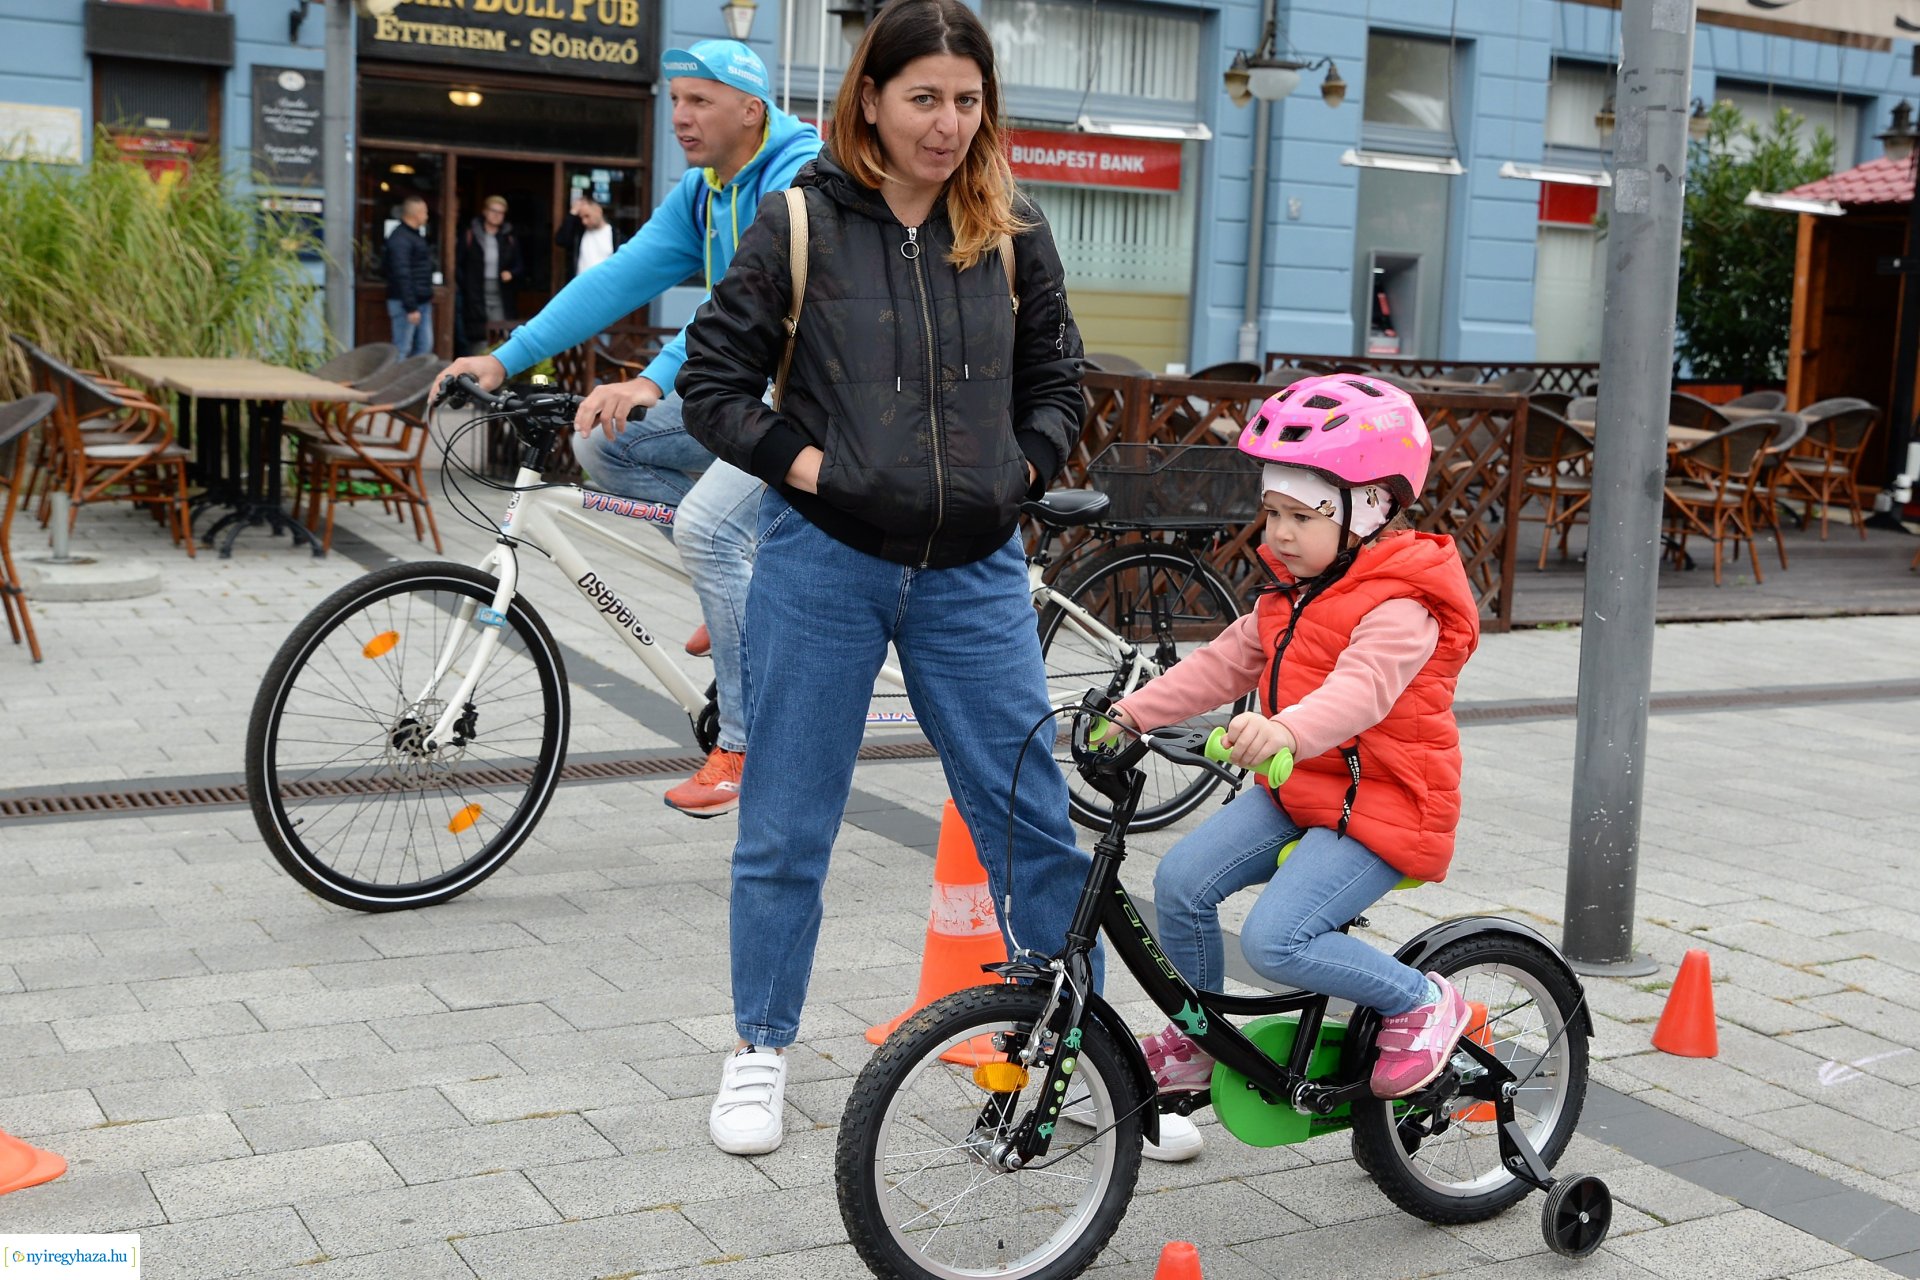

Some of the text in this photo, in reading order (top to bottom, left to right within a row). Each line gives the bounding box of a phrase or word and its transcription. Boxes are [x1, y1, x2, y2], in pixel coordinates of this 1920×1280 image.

[570, 0, 640, 27] PUB
[1011, 145, 1145, 174] BUDAPEST BANK
